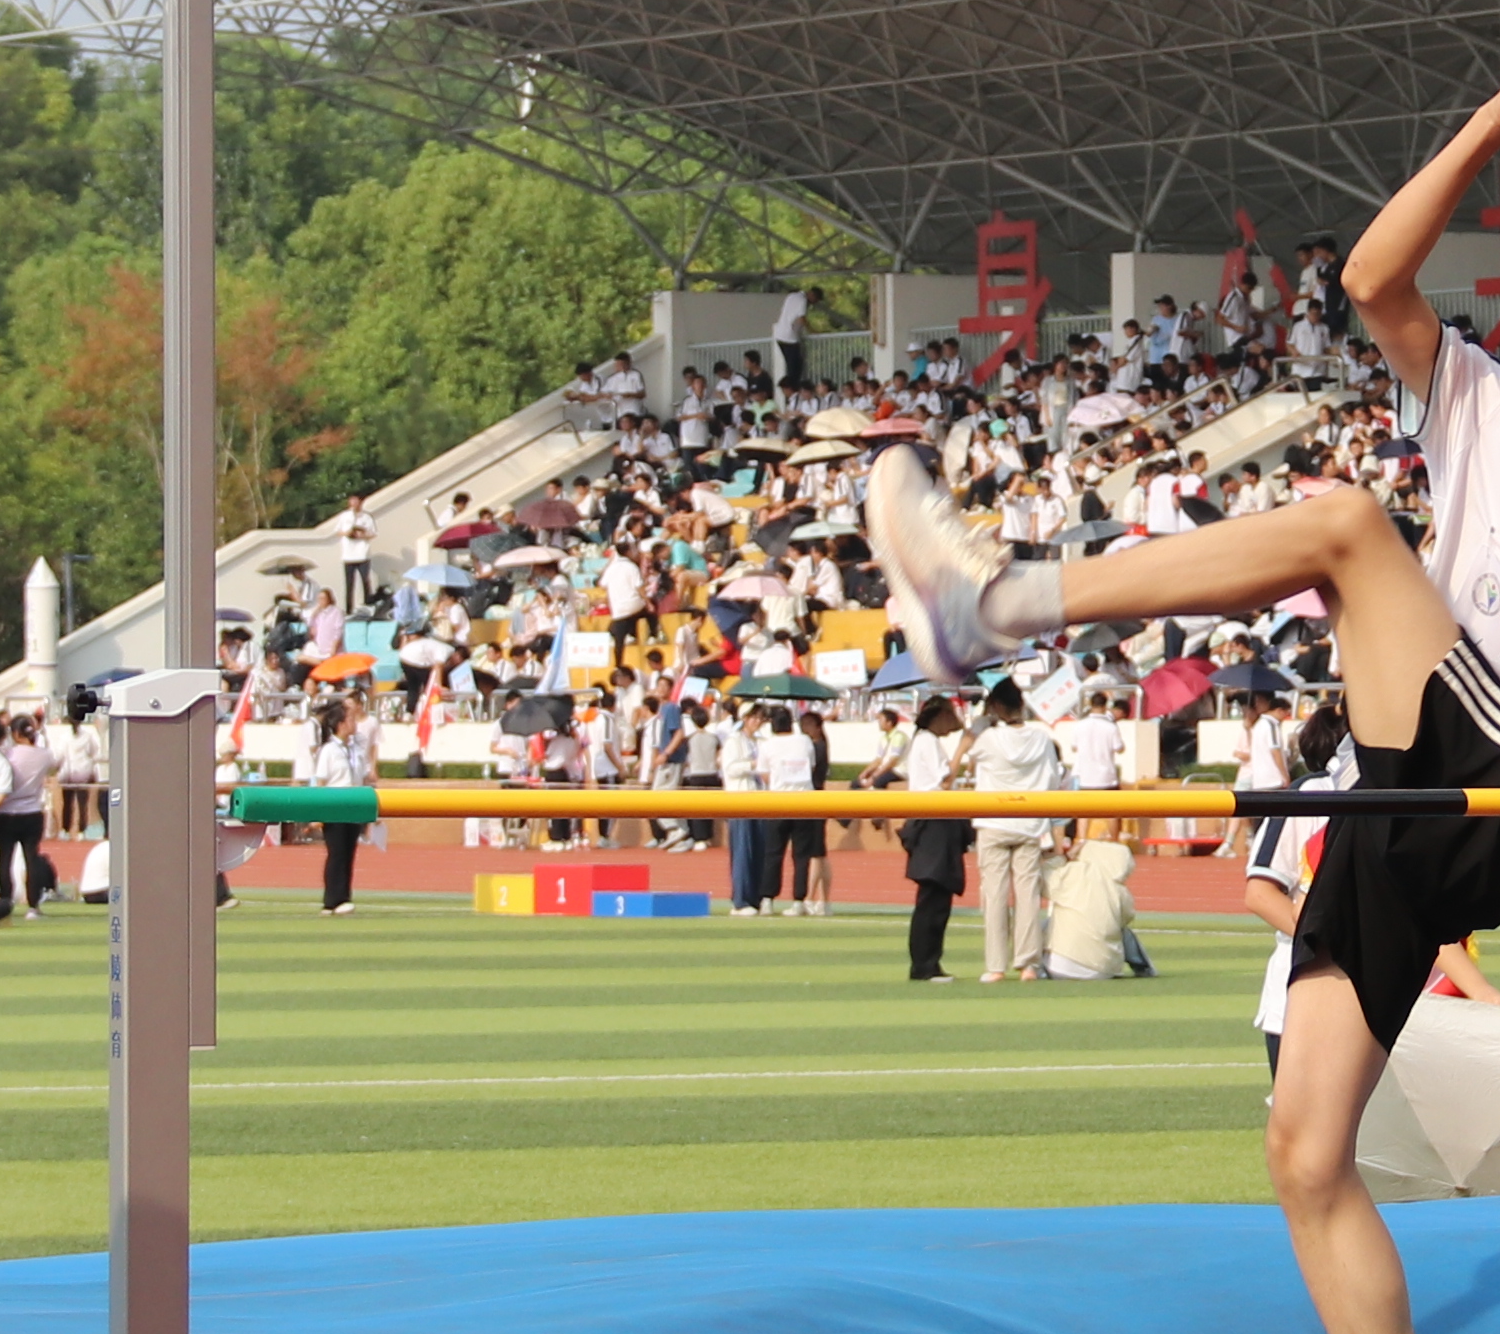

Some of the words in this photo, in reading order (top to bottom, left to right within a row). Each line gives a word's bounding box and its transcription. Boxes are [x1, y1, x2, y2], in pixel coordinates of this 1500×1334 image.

[498, 885, 509, 907] 2
[556, 877, 567, 904] 1
[616, 895, 625, 915] 3
